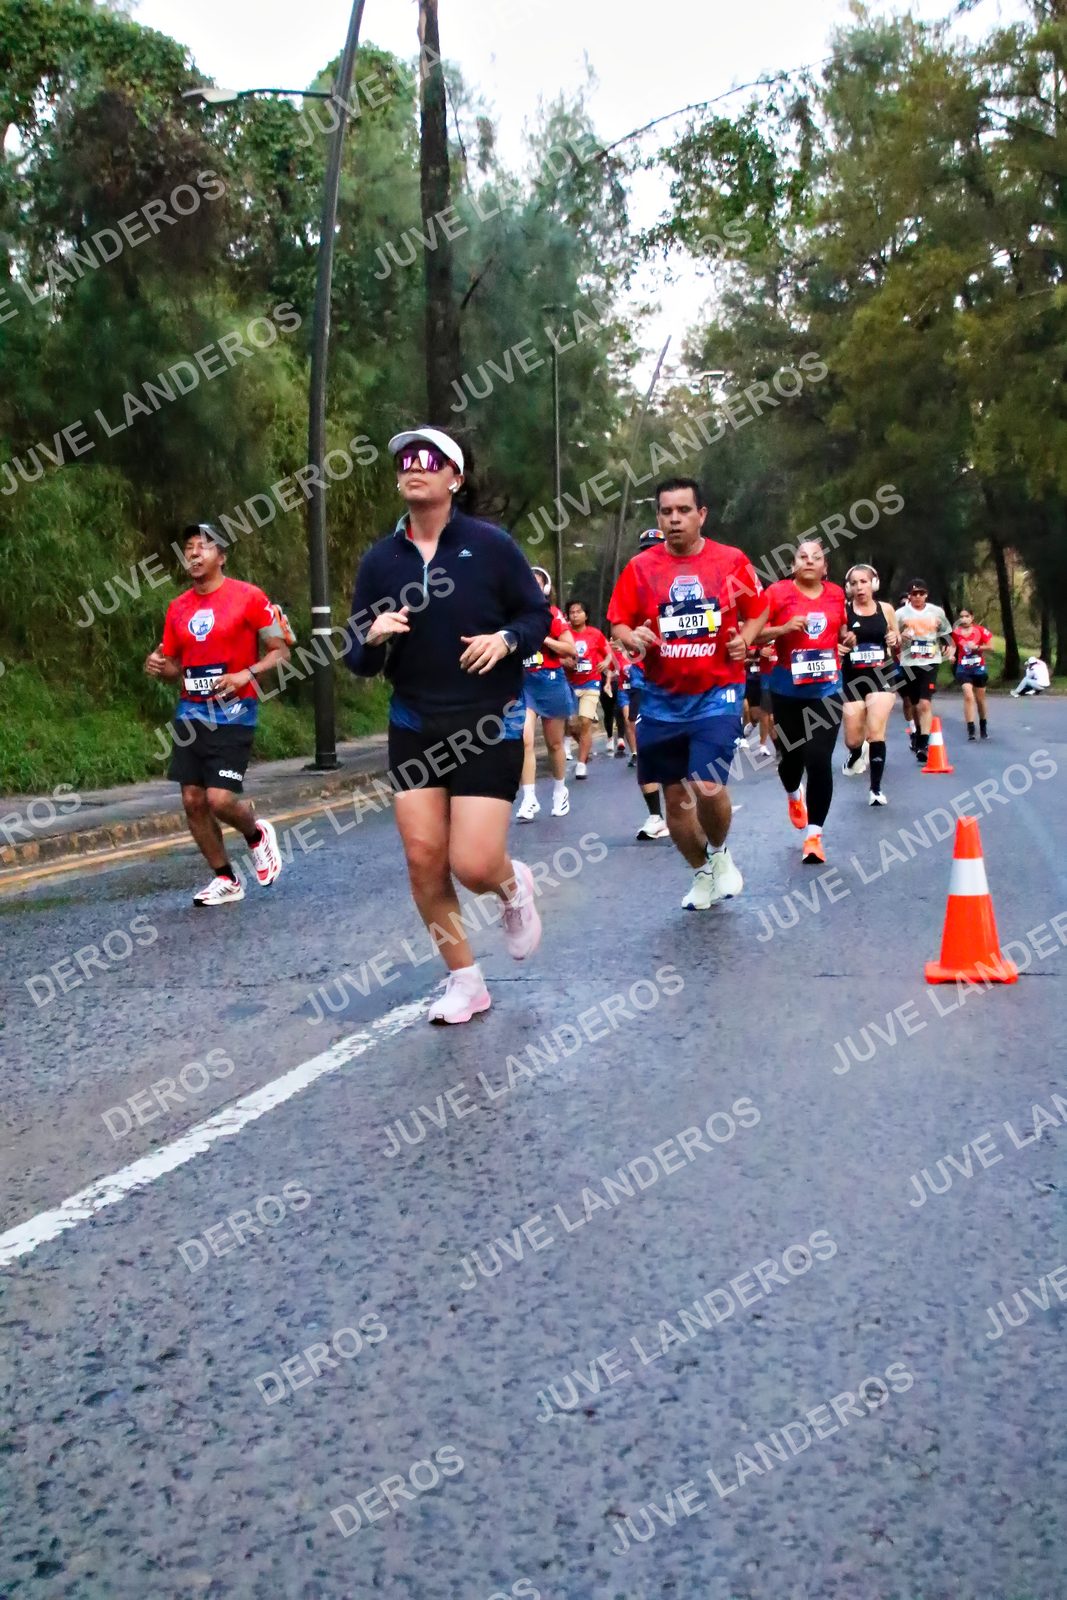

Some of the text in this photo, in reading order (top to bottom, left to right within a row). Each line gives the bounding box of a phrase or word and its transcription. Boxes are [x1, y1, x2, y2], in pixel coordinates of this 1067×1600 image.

[678, 614, 704, 628] 4287
[660, 643, 717, 658] SANTIAGO
[807, 661, 826, 672] 4155
[193, 678, 215, 690] 5434
